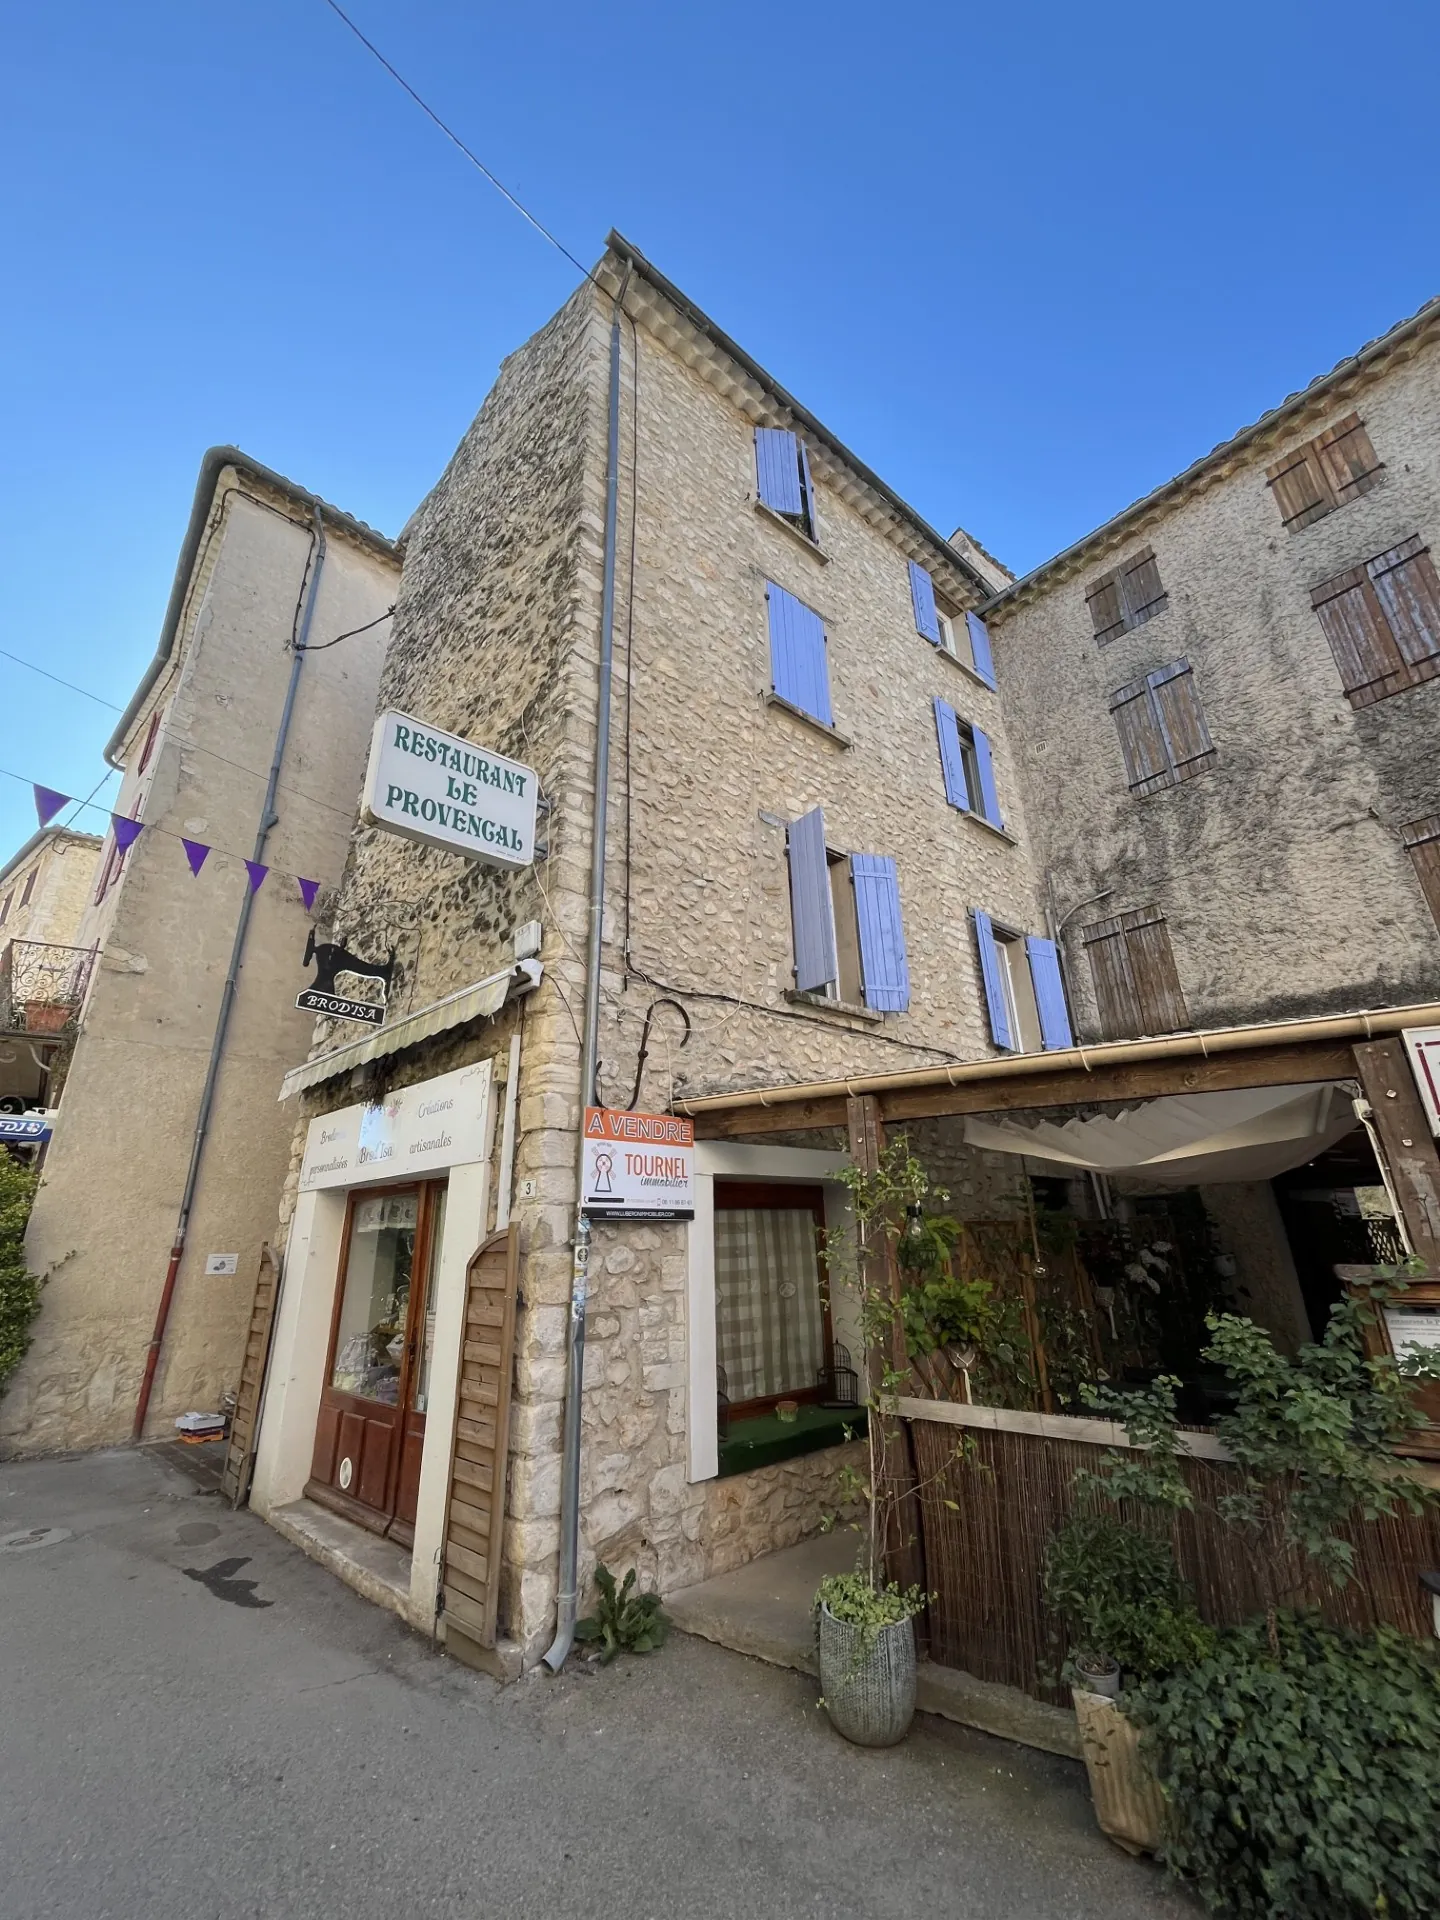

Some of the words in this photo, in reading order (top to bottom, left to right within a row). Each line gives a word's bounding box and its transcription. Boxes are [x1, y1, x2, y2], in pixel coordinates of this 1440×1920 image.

[394, 724, 527, 798] RESTAURANT
[446, 775, 478, 806] LE
[385, 784, 523, 852] PROVENCAL
[307, 995, 376, 1020] BROD'ISA
[588, 1112, 605, 1135] A
[609, 1115, 692, 1143] VENDRE
[409, 1130, 452, 1154] artisanales
[625, 1154, 689, 1179] TOURNEL
[525, 1182, 531, 1196] 3
[641, 1175, 689, 1189] immobilier
